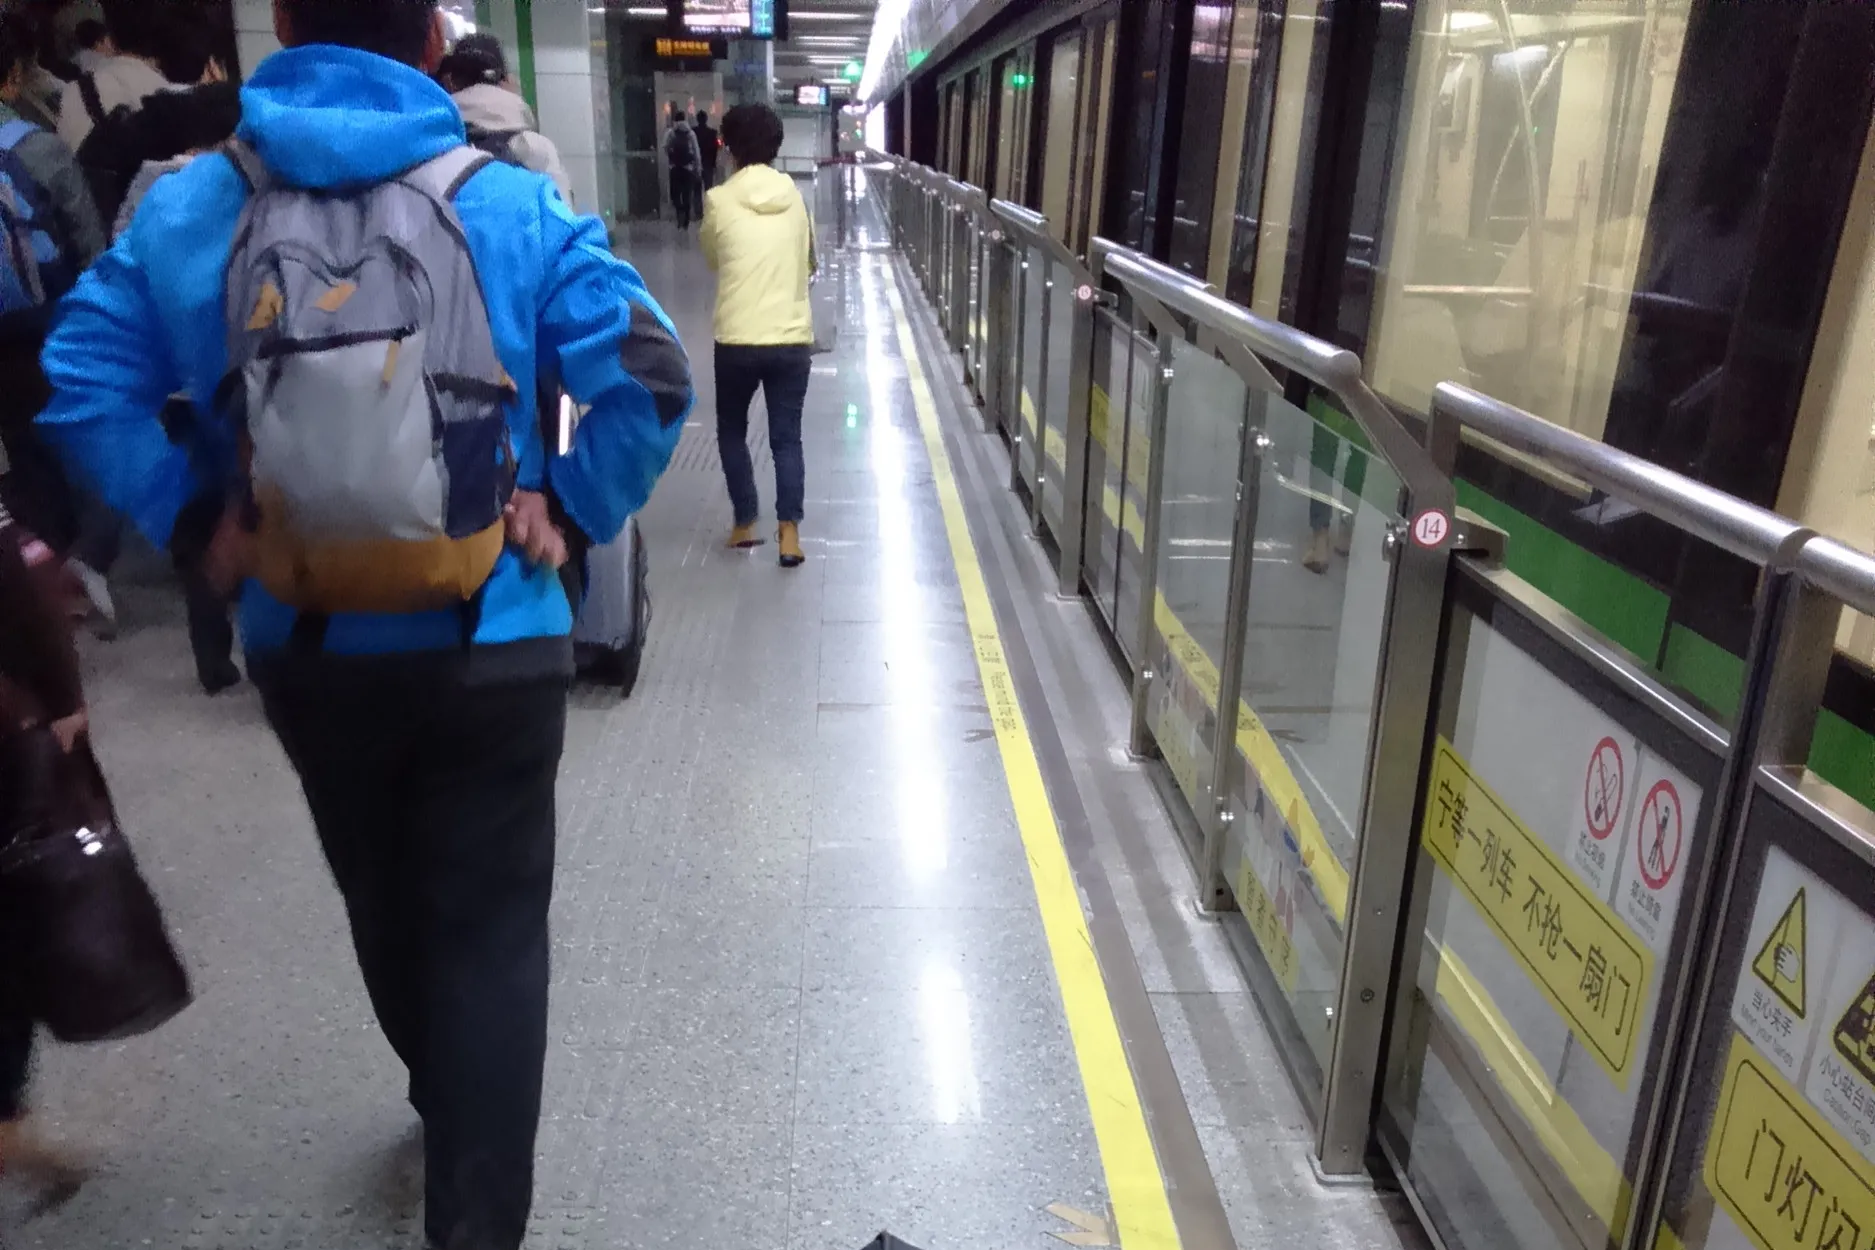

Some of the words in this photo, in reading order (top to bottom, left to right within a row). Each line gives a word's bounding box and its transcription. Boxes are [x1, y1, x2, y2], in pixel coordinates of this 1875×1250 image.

[1422, 518, 1441, 539] 14
[1438, 779, 1516, 904] 宁等一列车
[1522, 874, 1631, 1036] 不抢一扇门
